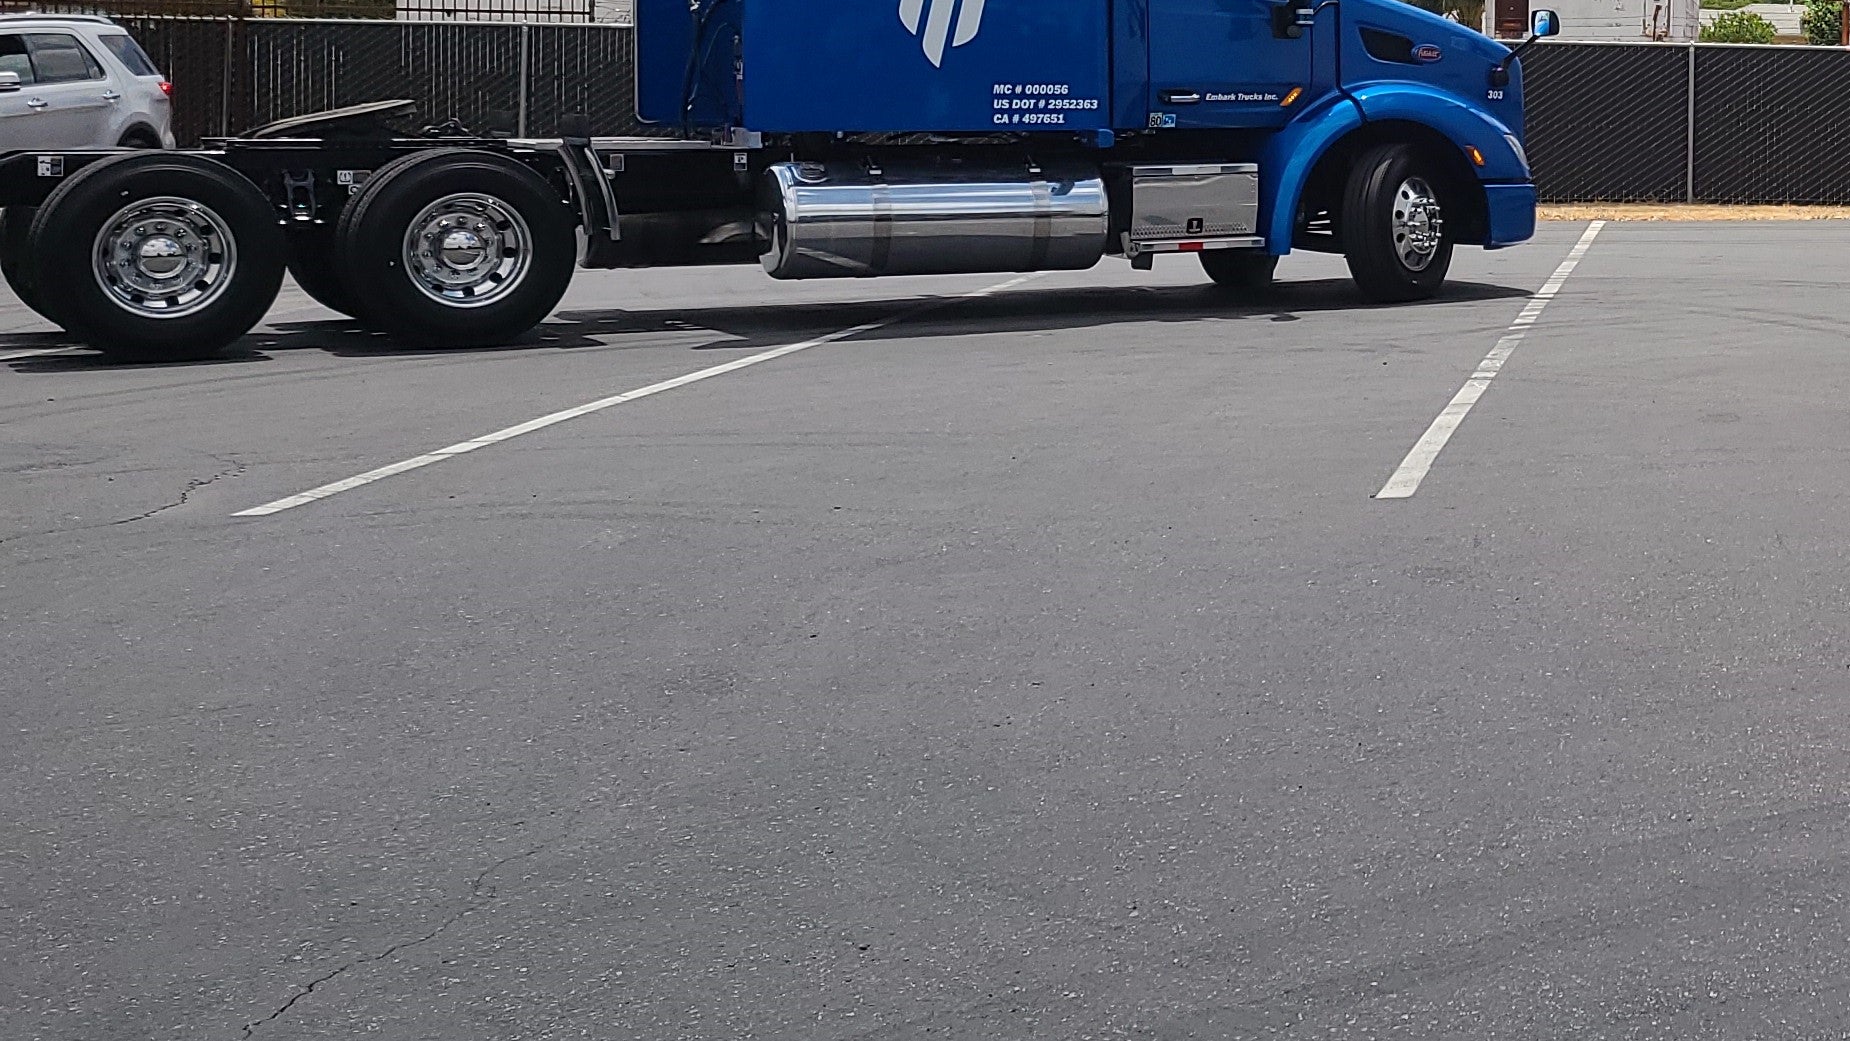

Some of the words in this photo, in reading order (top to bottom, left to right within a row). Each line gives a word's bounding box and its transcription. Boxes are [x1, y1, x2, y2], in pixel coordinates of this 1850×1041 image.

[993, 84, 1013, 95] MC
[1015, 84, 1023, 95] #
[1025, 84, 1069, 95] 000056
[1205, 93, 1236, 101] Embark
[1238, 93, 1263, 101] Trucks
[1264, 93, 1279, 101] Inc.
[1487, 90, 1504, 100] 303
[993, 99, 1010, 109] US
[1012, 99, 1037, 109] DOT
[1038, 99, 1046, 109] #
[1047, 99, 1099, 109] 2952363
[993, 114, 1010, 124] CA
[1012, 114, 1021, 124] #
[1022, 114, 1066, 124] 497651
